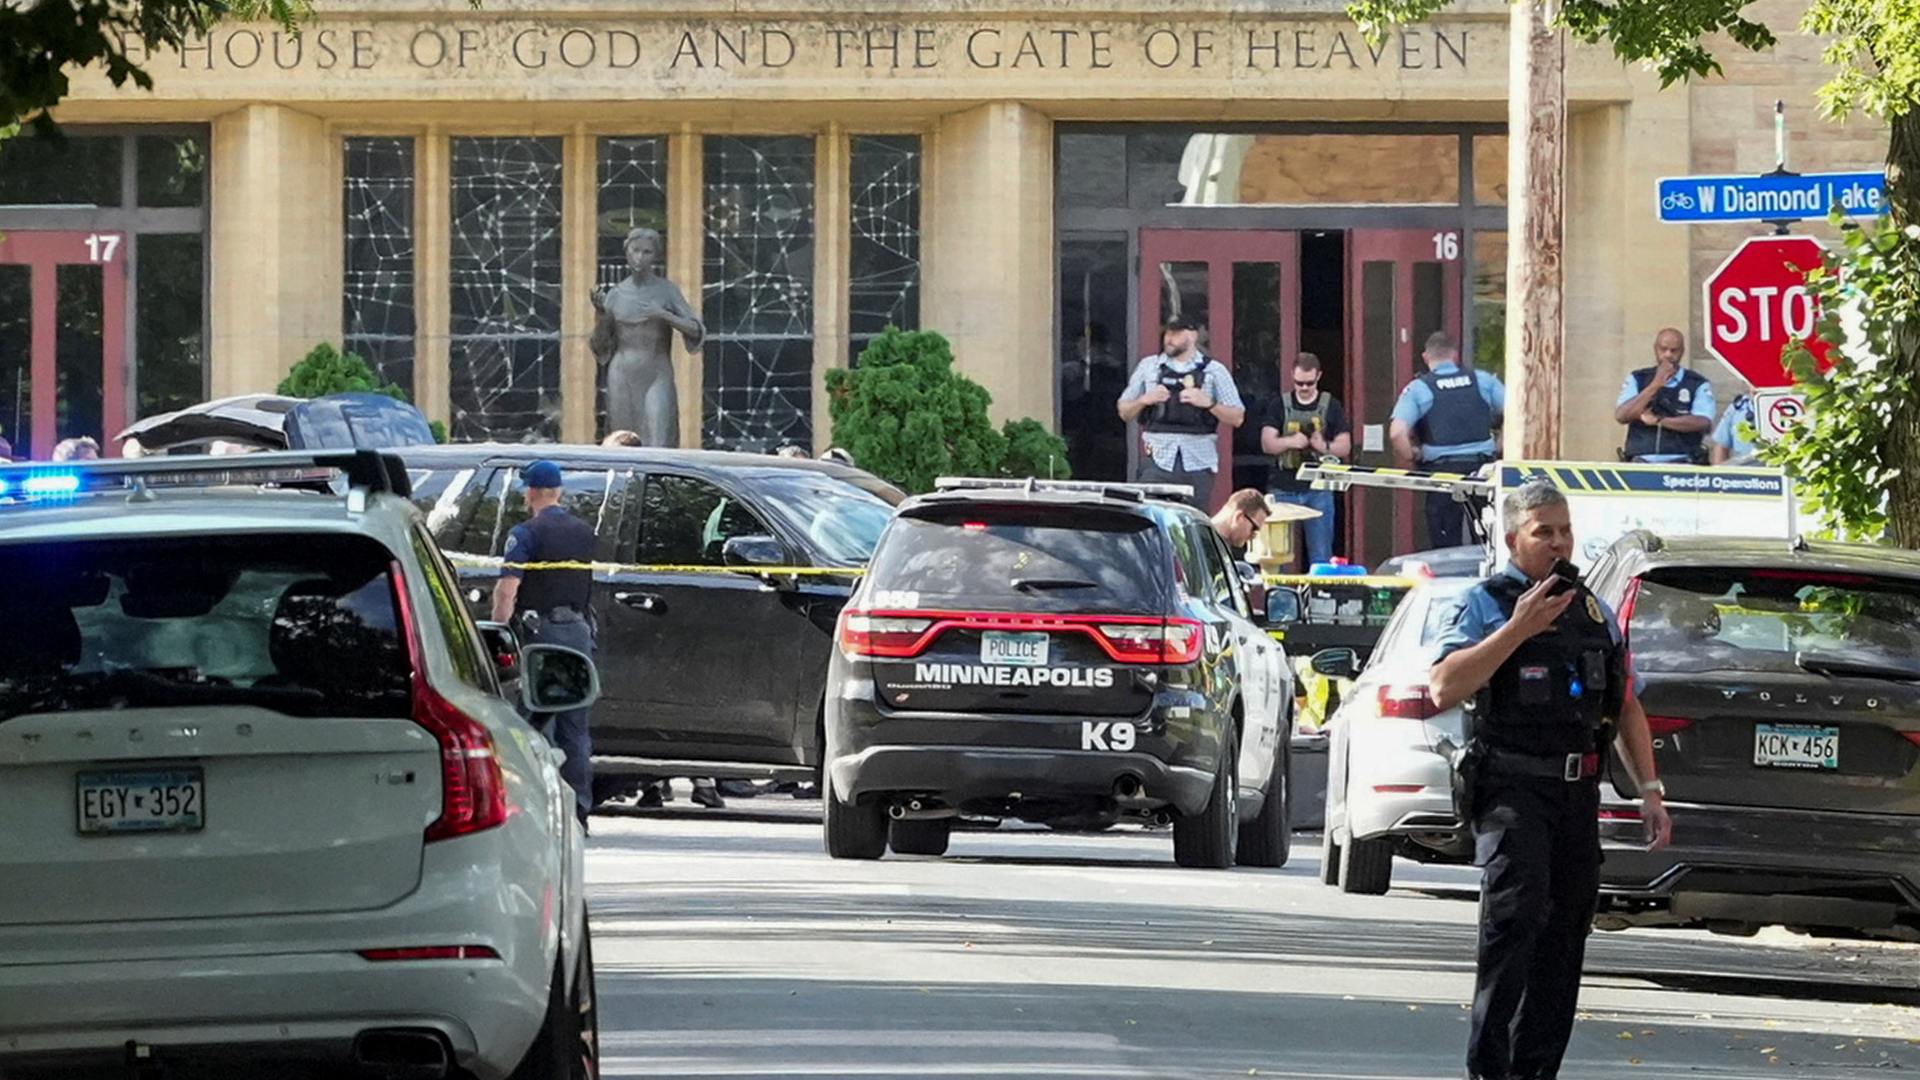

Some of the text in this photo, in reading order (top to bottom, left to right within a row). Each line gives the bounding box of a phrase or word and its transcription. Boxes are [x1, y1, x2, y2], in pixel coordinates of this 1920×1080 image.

[178, 29, 376, 70] HOUSE
[409, 29, 481, 70] OF
[512, 28, 642, 69] GOD
[669, 30, 797, 69] AND
[826, 30, 939, 69] THE
[965, 28, 1114, 69] GATE
[1144, 29, 1215, 69] OF
[1248, 30, 1469, 70] HEAVEN
[1696, 185, 1717, 214] W
[1723, 182, 1821, 213] Diamond
[84, 233, 120, 261] 17
[1431, 232, 1459, 261] 16
[1715, 285, 1825, 344] STO
[1662, 474, 1781, 493] Special Operations
[989, 639, 1038, 658] POLICE
[915, 662, 1115, 688] MINNEAPOLIS
[1081, 721, 1136, 752] K9
[1758, 735, 1835, 759] KCK 456
[84, 785, 197, 819] EGY 352
